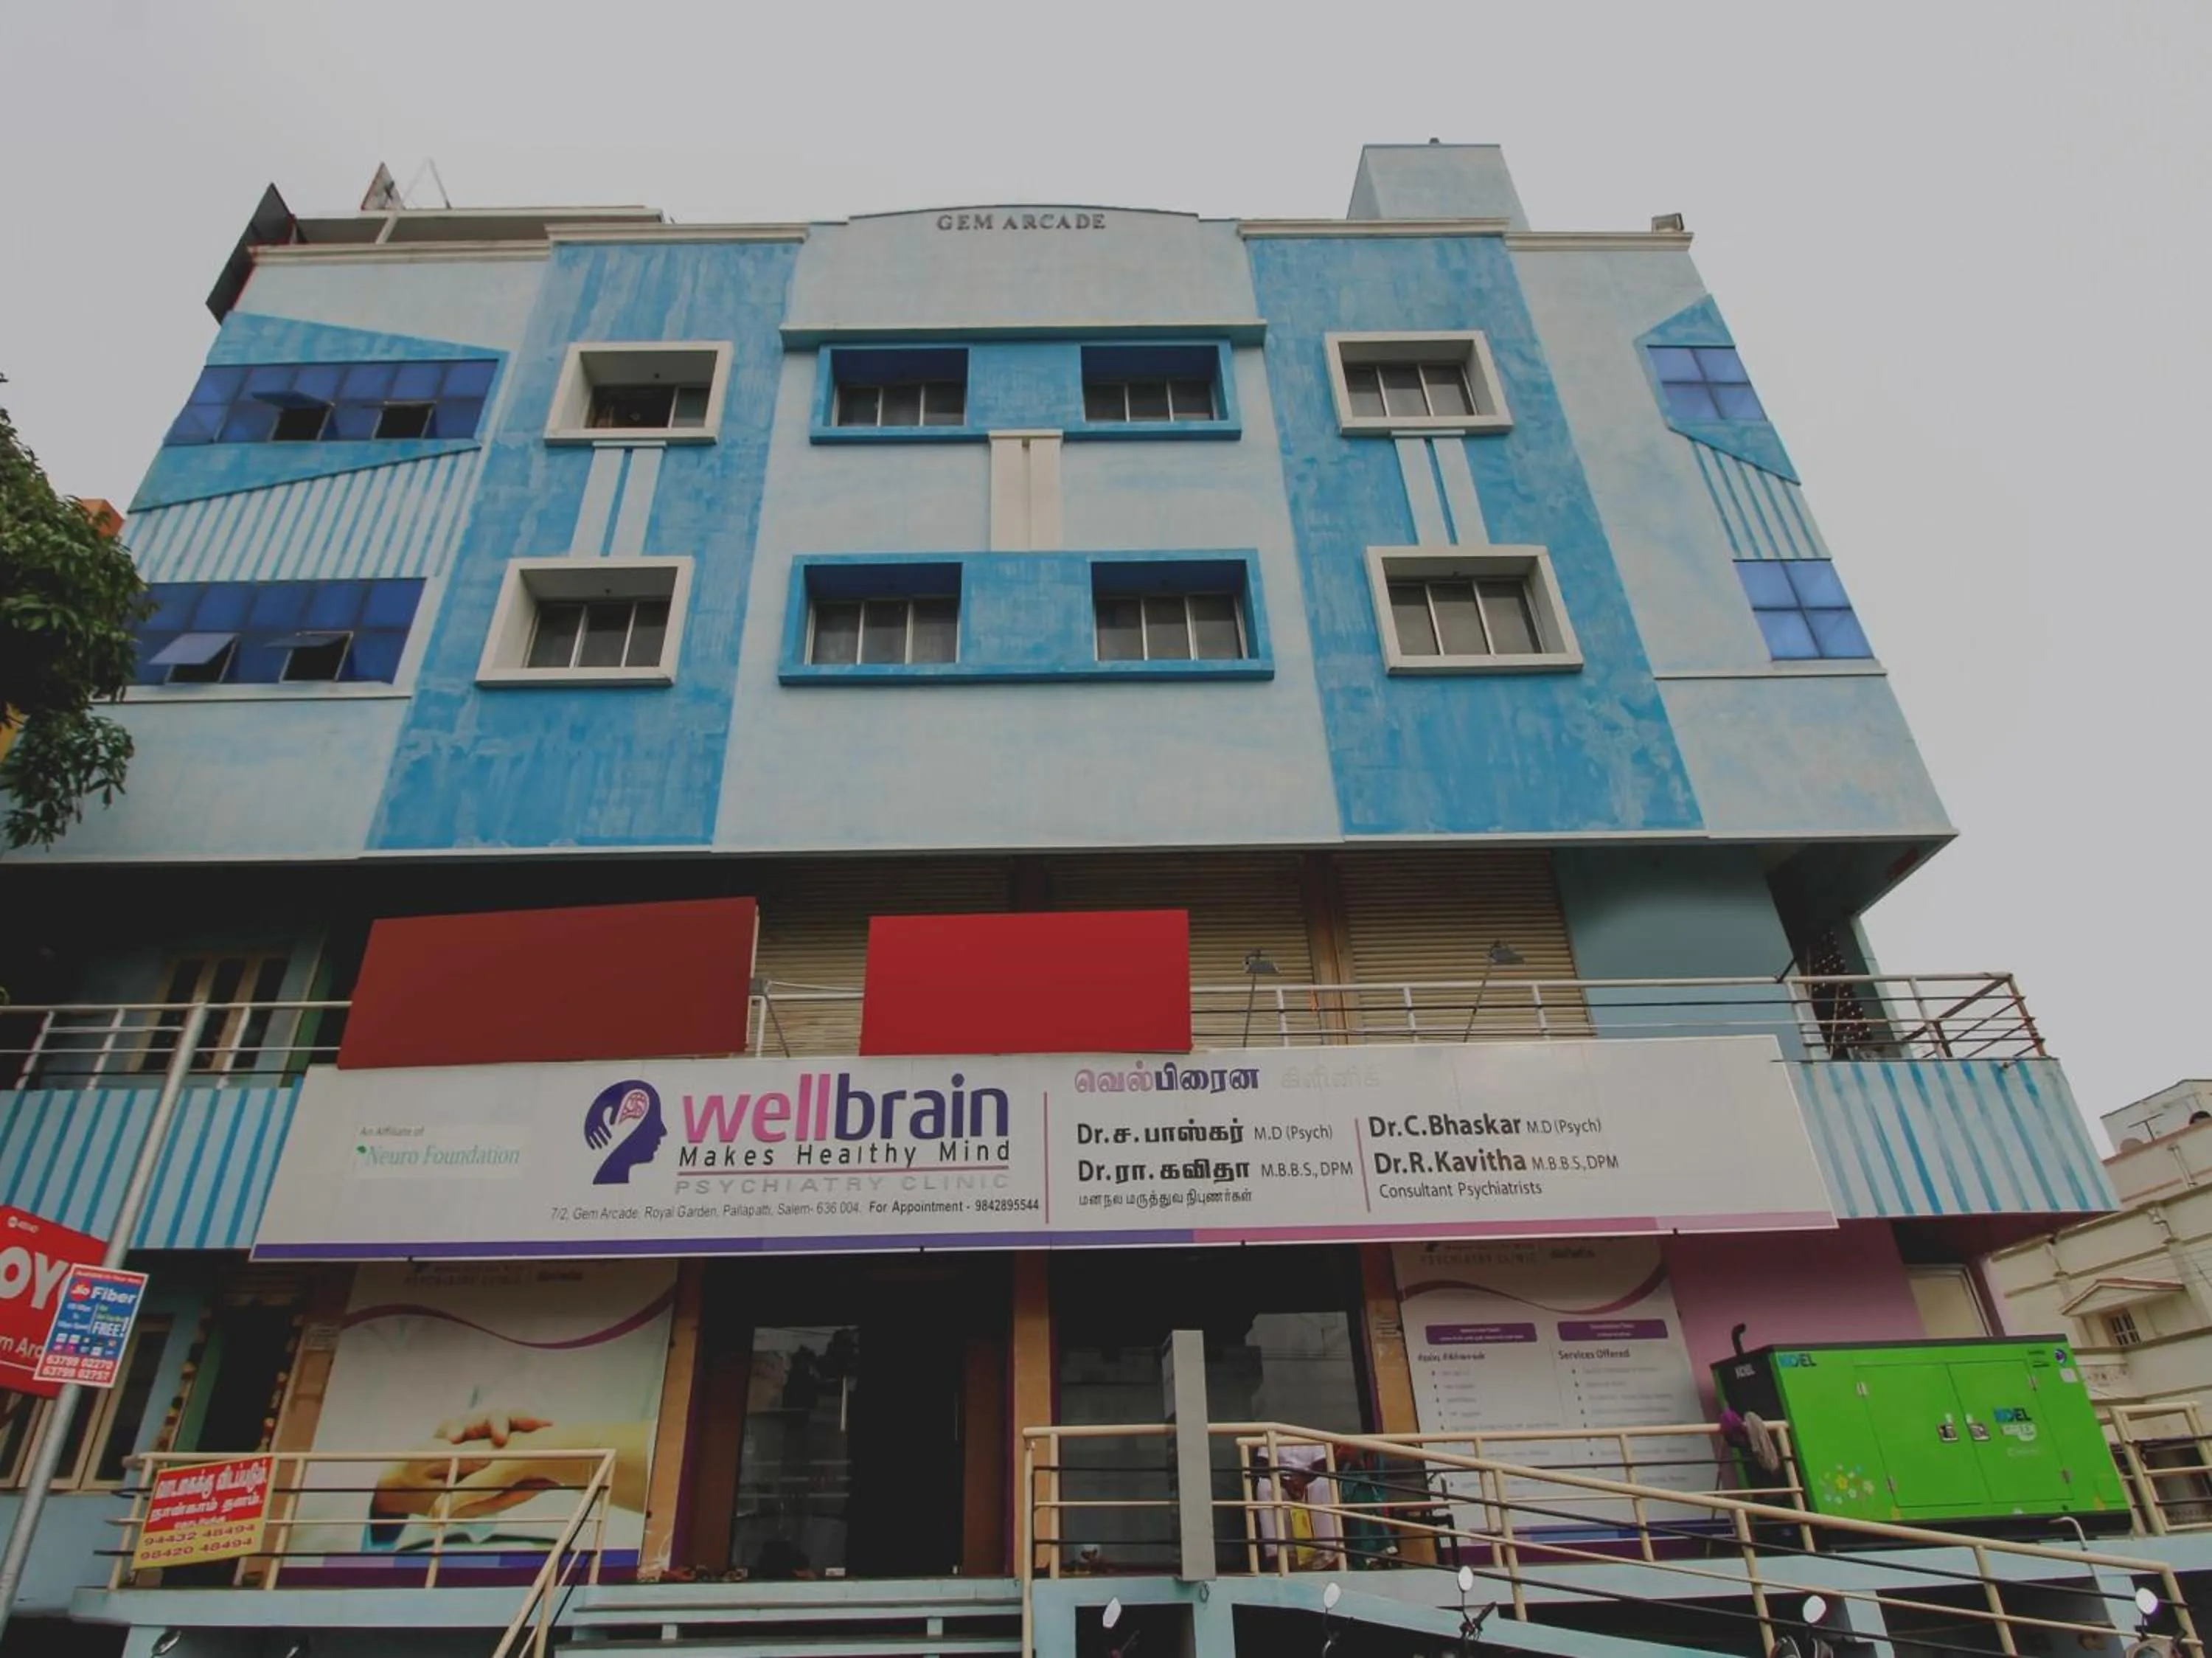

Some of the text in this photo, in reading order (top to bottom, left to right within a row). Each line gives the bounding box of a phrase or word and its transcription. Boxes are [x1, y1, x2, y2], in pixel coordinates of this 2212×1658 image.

[936, 213, 1106, 231] GEM ARCADE
[681, 1072, 1010, 1144] wellbrain
[369, 1145, 520, 1165] Neuro Foundation
[678, 1140, 1011, 1168] Makes Healthy Mind
[674, 1175, 1010, 1195] PSYCHIATRY CLINIC
[1380, 1179, 1543, 1200] Consultant Psychiatrists
[573, 1207, 599, 1220] Gem
[644, 1206, 674, 1221] Royal
[816, 1201, 838, 1215] 636
[869, 1201, 888, 1213] For
[891, 1200, 964, 1215] Appointment
[975, 1199, 1040, 1212] 9842895544
[0, 1246, 69, 1311] OY
[90, 1286, 137, 1305] Fiber
[92, 1317, 130, 1337] FREE!
[1558, 1348, 1630, 1360] Services Offered
